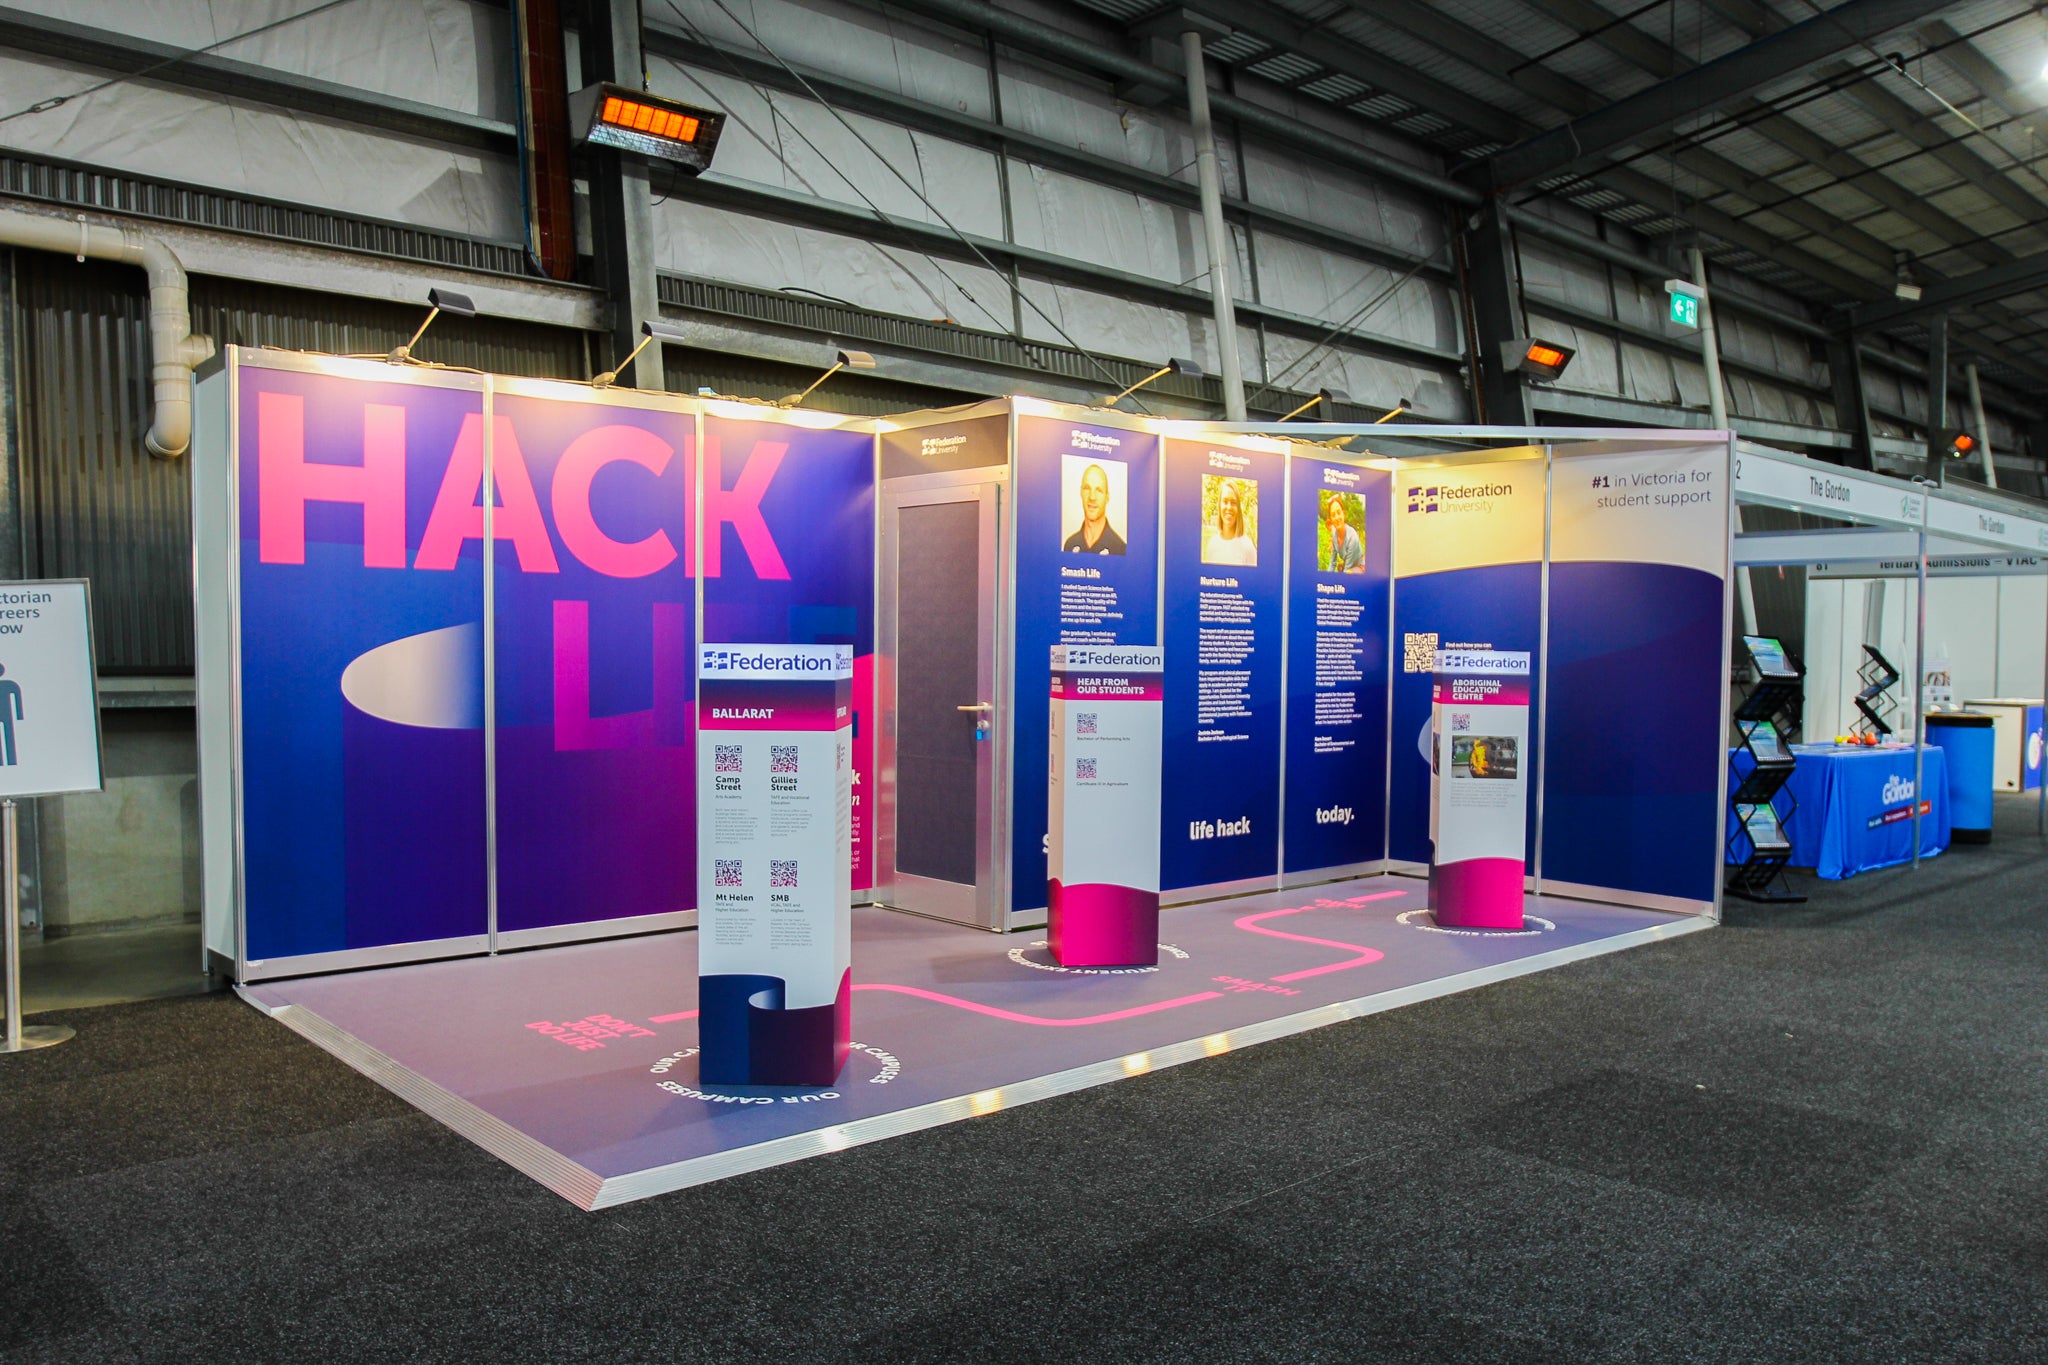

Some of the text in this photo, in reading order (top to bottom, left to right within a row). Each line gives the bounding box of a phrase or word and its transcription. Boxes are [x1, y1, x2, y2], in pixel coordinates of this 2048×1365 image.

[935, 436, 966, 446] Federation
[1086, 433, 1120, 446] Federation
[258, 391, 791, 580] HACK
[1592, 470, 1712, 489] #1 in Victoria for
[1440, 484, 1512, 500] Federation
[1810, 476, 1850, 502] The Gordon
[1597, 490, 1711, 508] student support
[1440, 500, 1494, 514] University
[1061, 566, 1101, 578] Smash Life
[1200, 576, 1238, 588] Nurture Life
[1317, 583, 1346, 594] Shape Life
[0, 591, 52, 604] torian
[0, 624, 23, 634] ow
[730, 652, 832, 671] Federation
[1088, 652, 1161, 666] Federation
[1462, 656, 1527, 669] Federation
[1077, 678, 1129, 686] HEAR FROM
[1452, 679, 1502, 687] ABORIGINAL
[1077, 686, 1097, 694] OUR
[1452, 686, 1499, 694] EDUCATION
[712, 708, 774, 718] BALLARAT
[716, 776, 740, 786] Camp
[771, 776, 798, 784] Gillies
[716, 783, 742, 791] Street
[1316, 805, 1355, 824] today.
[1190, 816, 1250, 840] life hack
[1070, 966, 1160, 975] STUDENT
[1212, 975, 1302, 995] SMASH
[562, 1020, 622, 1039] JUST
[584, 1014, 656, 1037] DON'T
[524, 1021, 606, 1052] DO LIFE
[650, 1057, 680, 1073] OUR
[864, 1046, 901, 1085] CAMPUSES
[656, 1080, 841, 1104] OUR CAMPUSES
